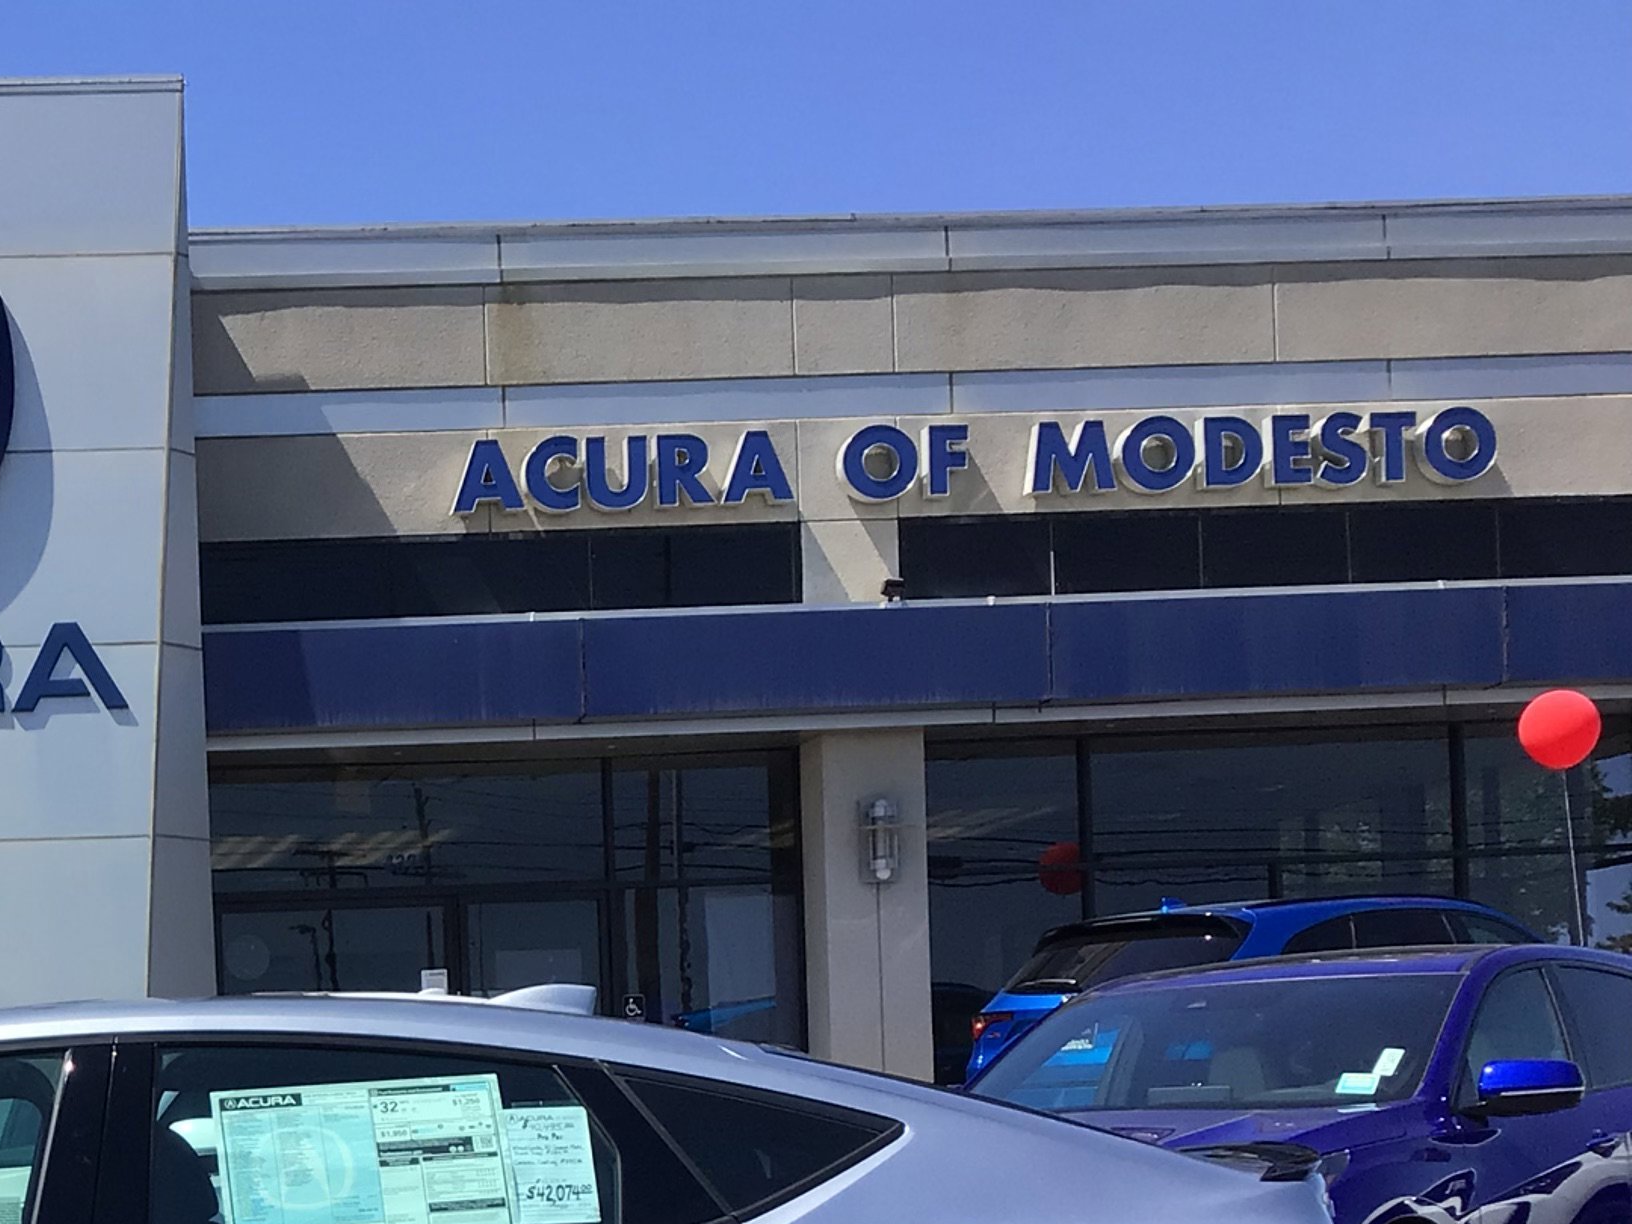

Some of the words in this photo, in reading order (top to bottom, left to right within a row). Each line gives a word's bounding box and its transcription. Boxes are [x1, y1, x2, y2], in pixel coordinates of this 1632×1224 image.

[451, 430, 796, 516] ACURA
[836, 424, 970, 503] OF
[1024, 406, 1499, 497] MODESTO
[237, 1095, 297, 1109] ACURA
[379, 1101, 400, 1113] 32
